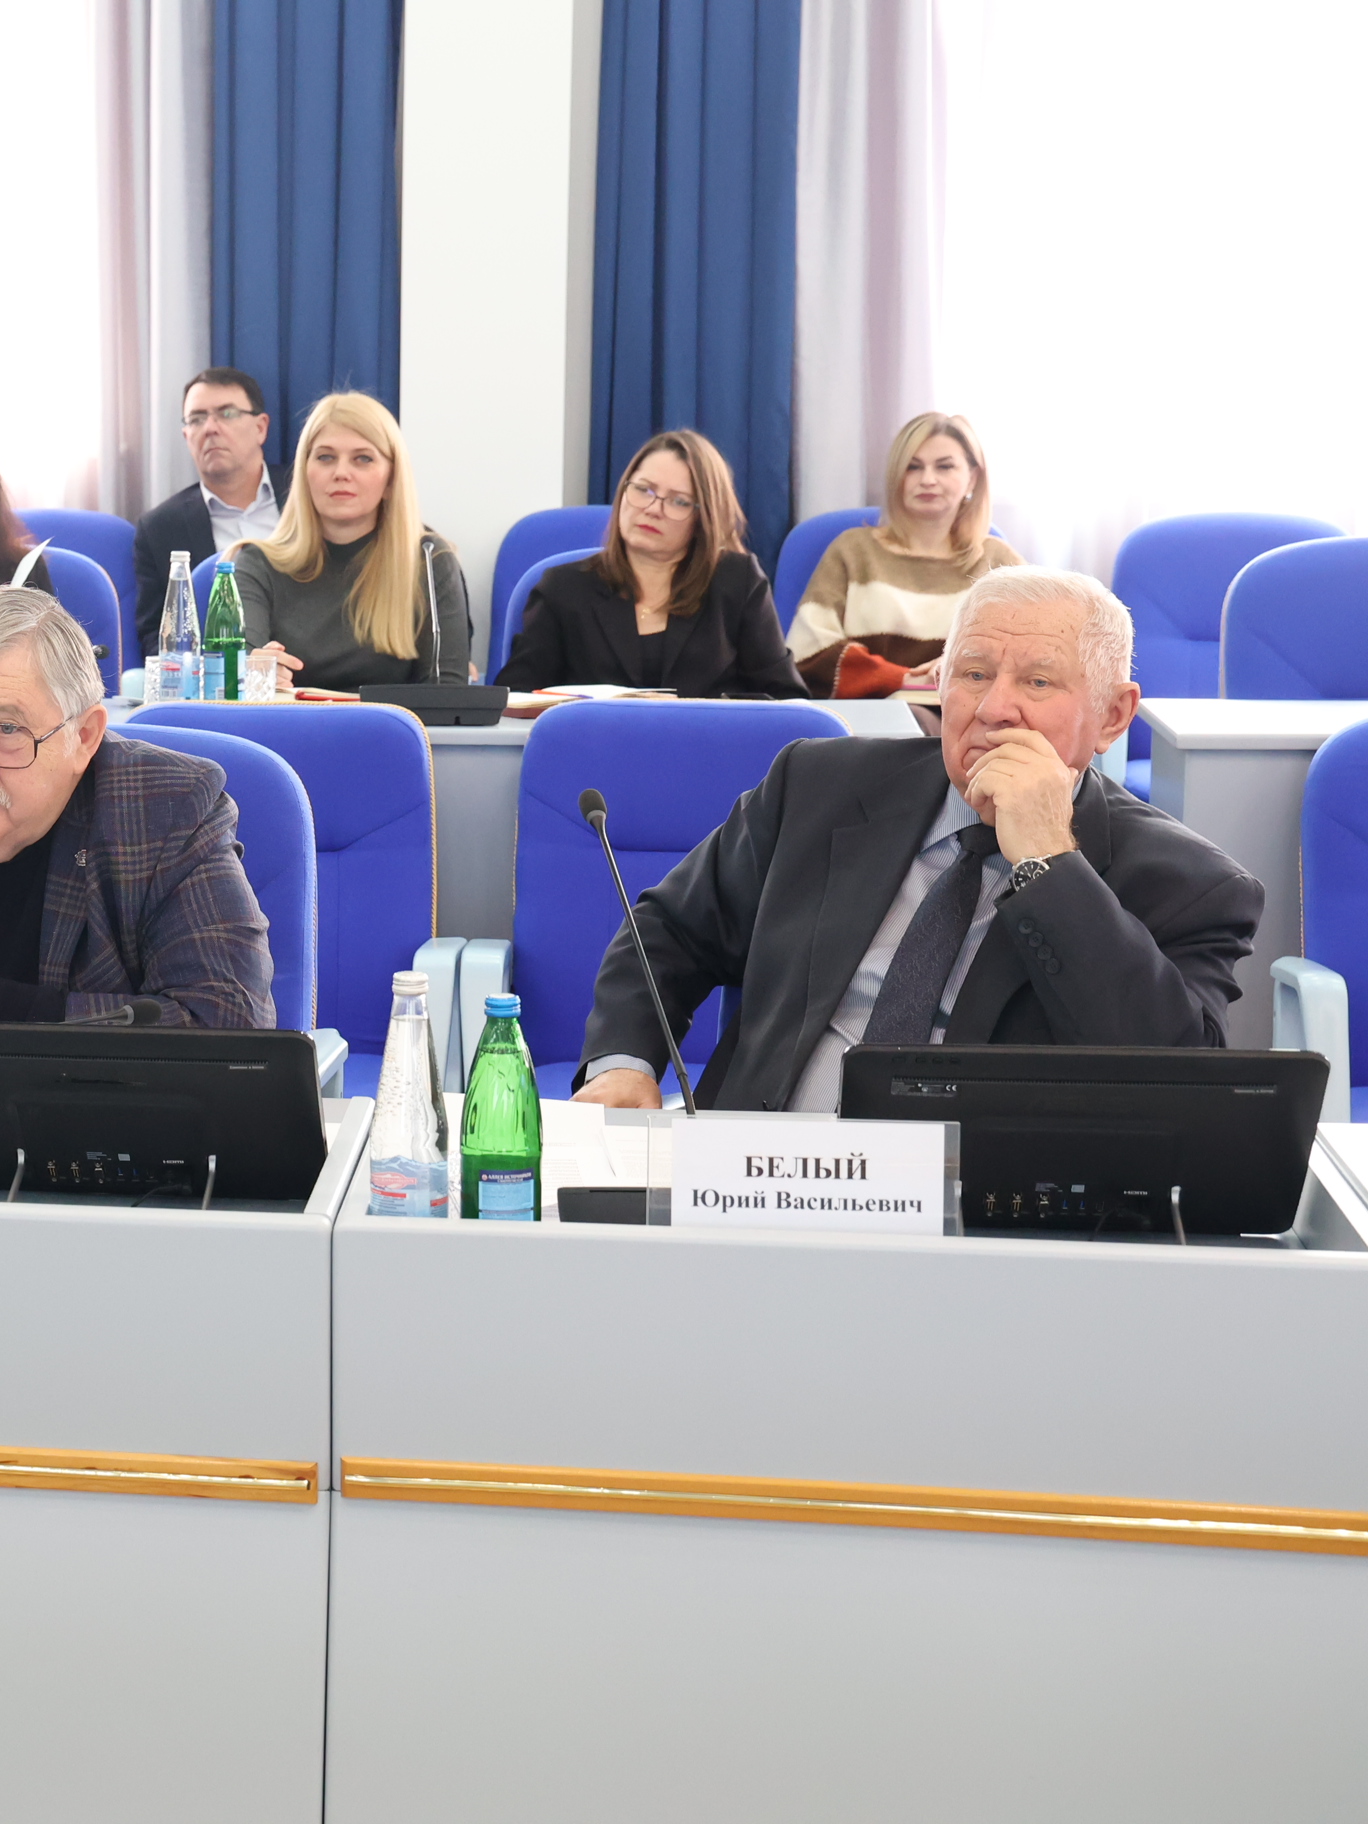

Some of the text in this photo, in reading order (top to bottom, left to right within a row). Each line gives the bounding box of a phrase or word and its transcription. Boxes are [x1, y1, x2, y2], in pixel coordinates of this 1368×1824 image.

[743, 1152, 869, 1181] БЕЛЫЙ
[691, 1188, 922, 1213] Юрий Васильевич
